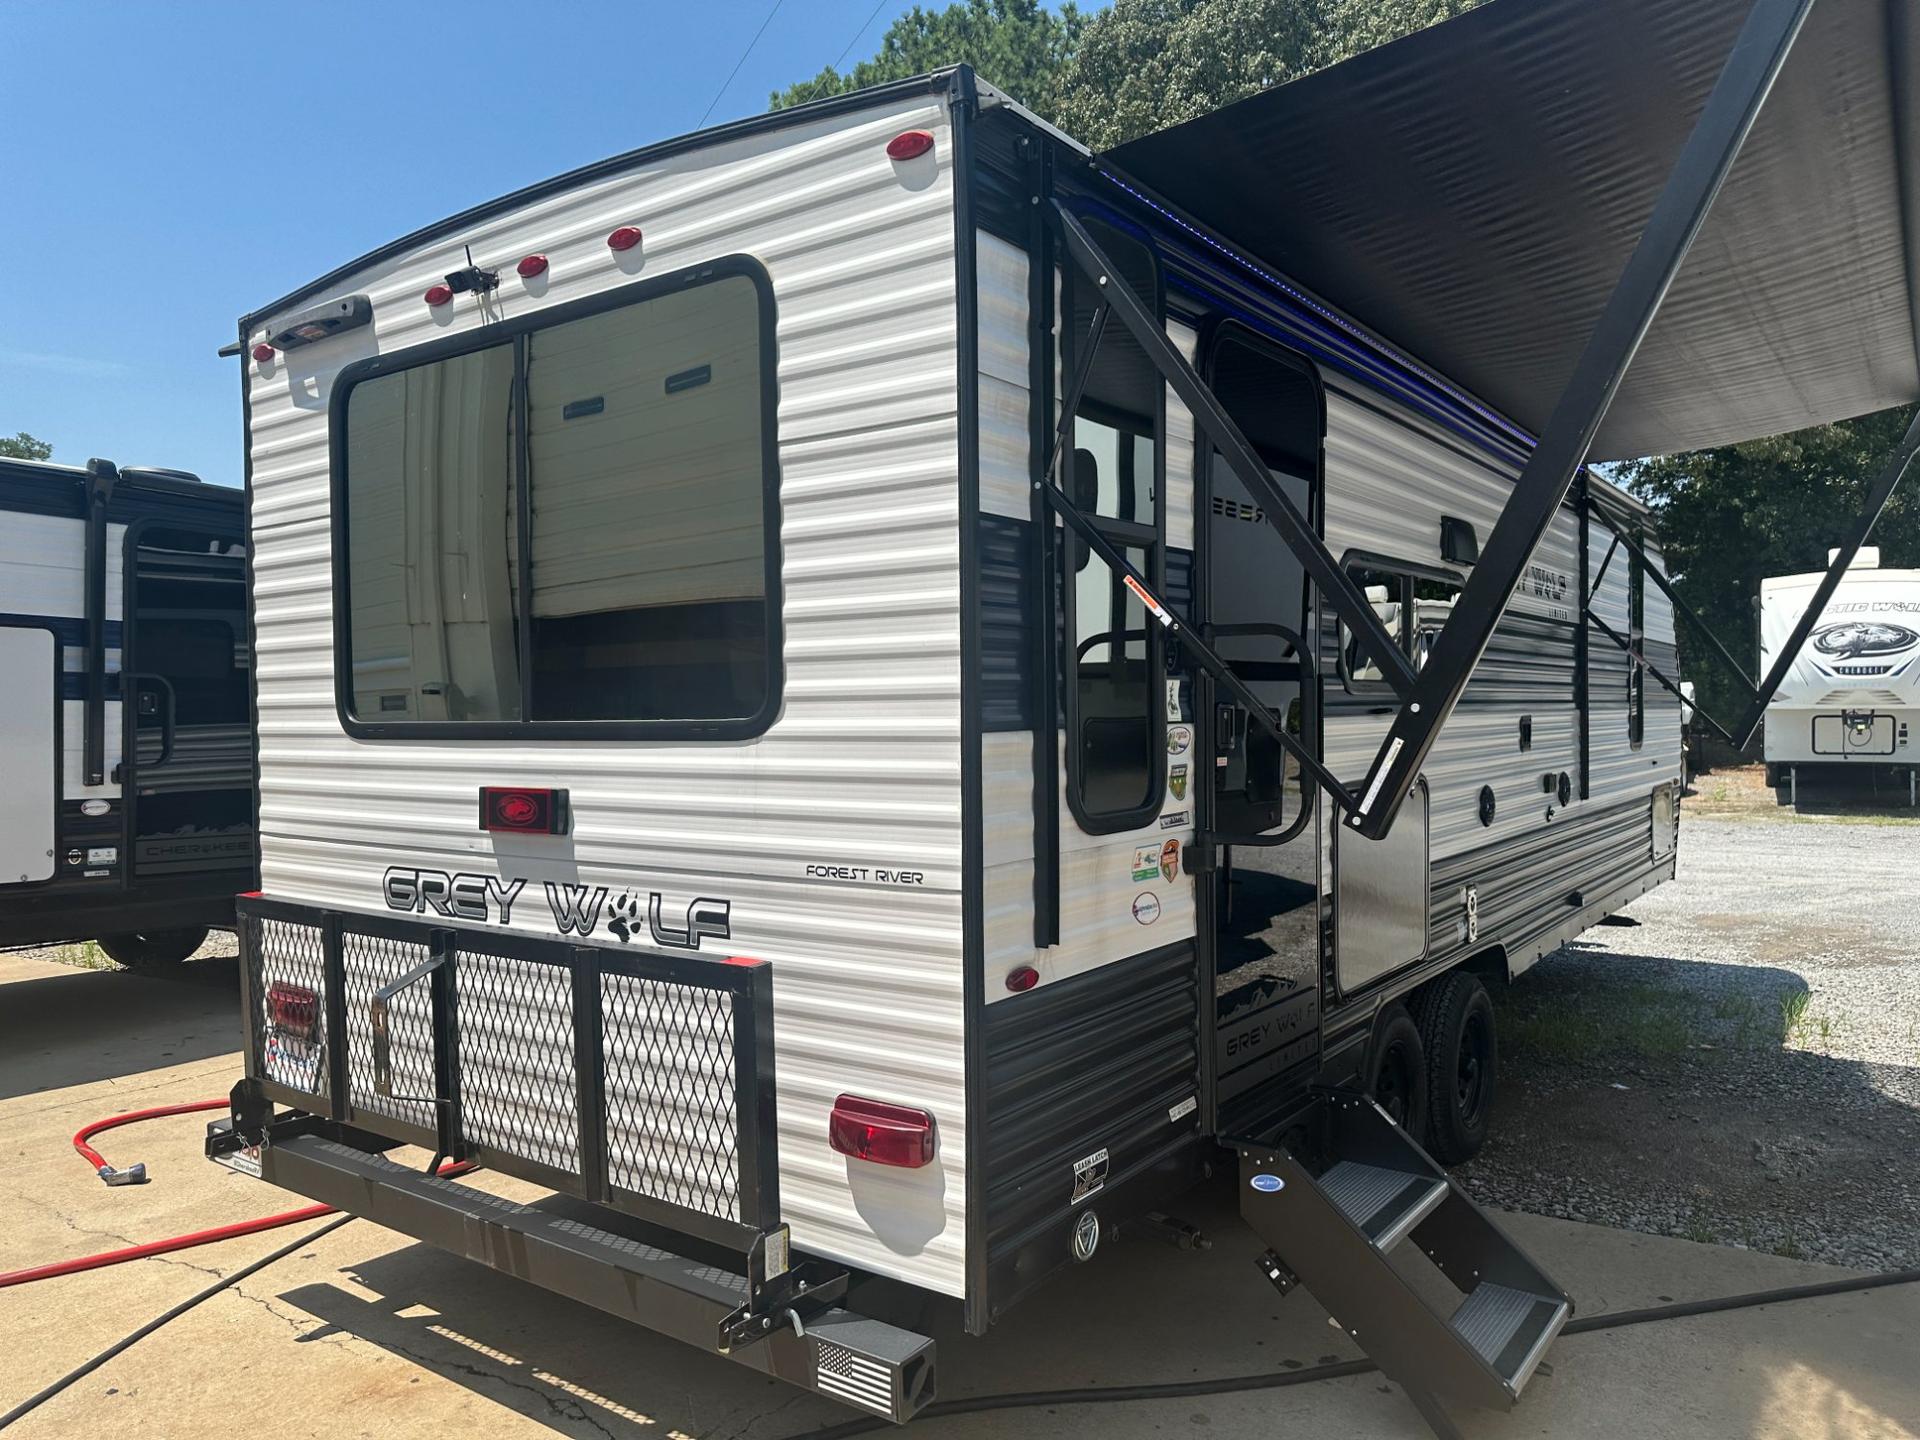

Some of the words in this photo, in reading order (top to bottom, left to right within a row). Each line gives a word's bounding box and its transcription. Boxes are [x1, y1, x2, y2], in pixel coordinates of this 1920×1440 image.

[806, 864, 869, 881] FOREST
[875, 869, 925, 886] RIVER
[382, 865, 528, 925] GREY
[1226, 1021, 1271, 1057] GREY
[1074, 1158, 1092, 1172] LEASH
[1091, 1150, 1107, 1164] LATCH
